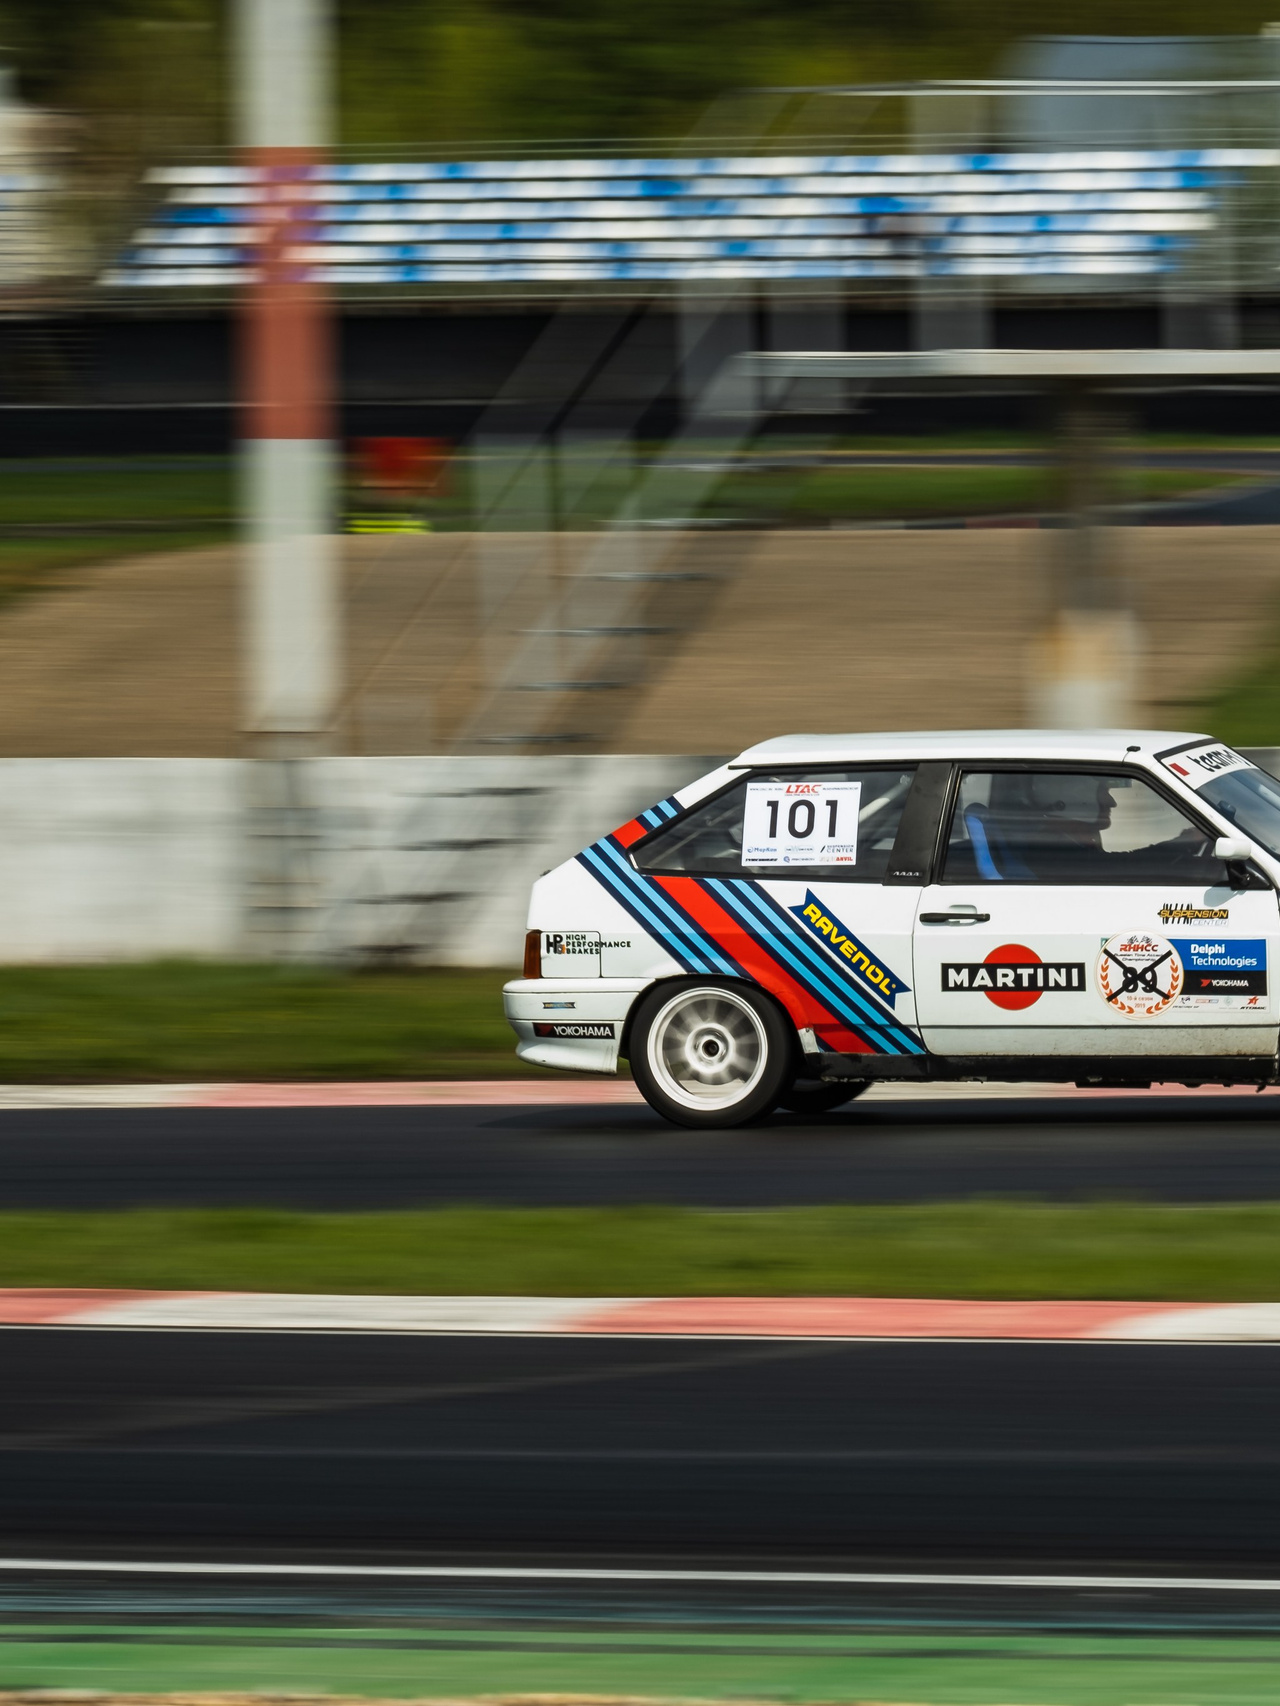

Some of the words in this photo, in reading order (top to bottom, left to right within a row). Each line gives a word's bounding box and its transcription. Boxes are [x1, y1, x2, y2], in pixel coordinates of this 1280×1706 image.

[785, 784, 822, 794] LTAC
[767, 799, 838, 839] 101
[1160, 909, 1228, 919] SUSPENSION
[566, 947, 600, 955] BRAKES
[803, 903, 892, 996] RAVENOL
[1190, 944, 1225, 956] Delphi
[1191, 955, 1257, 968] Technologies
[948, 968, 1078, 987] MARTINI
[1211, 979, 1249, 987] YOKOHAMA
[554, 1026, 612, 1036] YOKOHAMA
